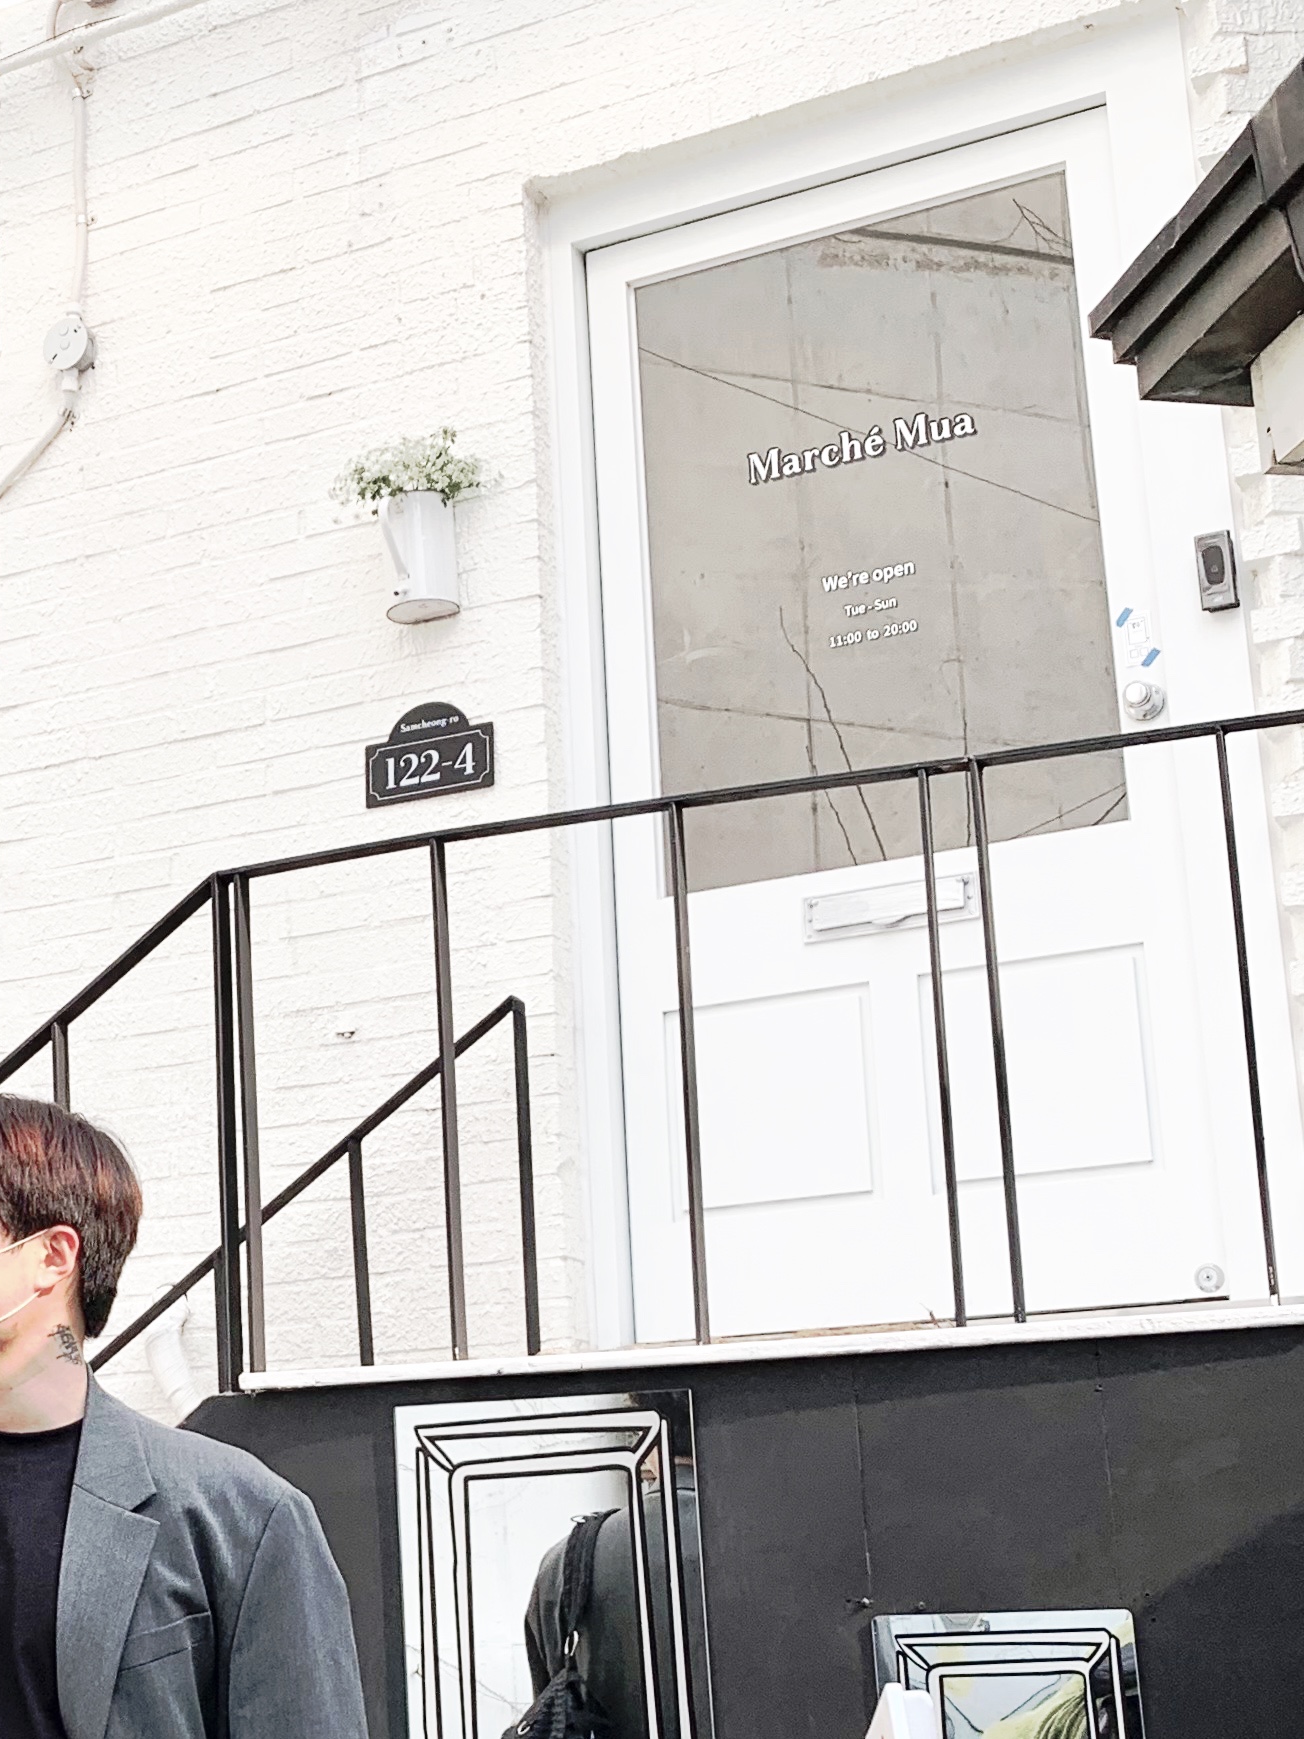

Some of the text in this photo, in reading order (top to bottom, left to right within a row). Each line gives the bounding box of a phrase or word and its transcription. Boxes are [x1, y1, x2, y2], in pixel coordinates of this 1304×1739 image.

[748, 413, 976, 484] Marché Mua
[822, 562, 915, 593] We're open
[844, 604, 866, 617] Tue
[874, 597, 898, 612] Sun
[829, 620, 918, 648] 11:00 to 20:00
[386, 743, 475, 790] 122-4
